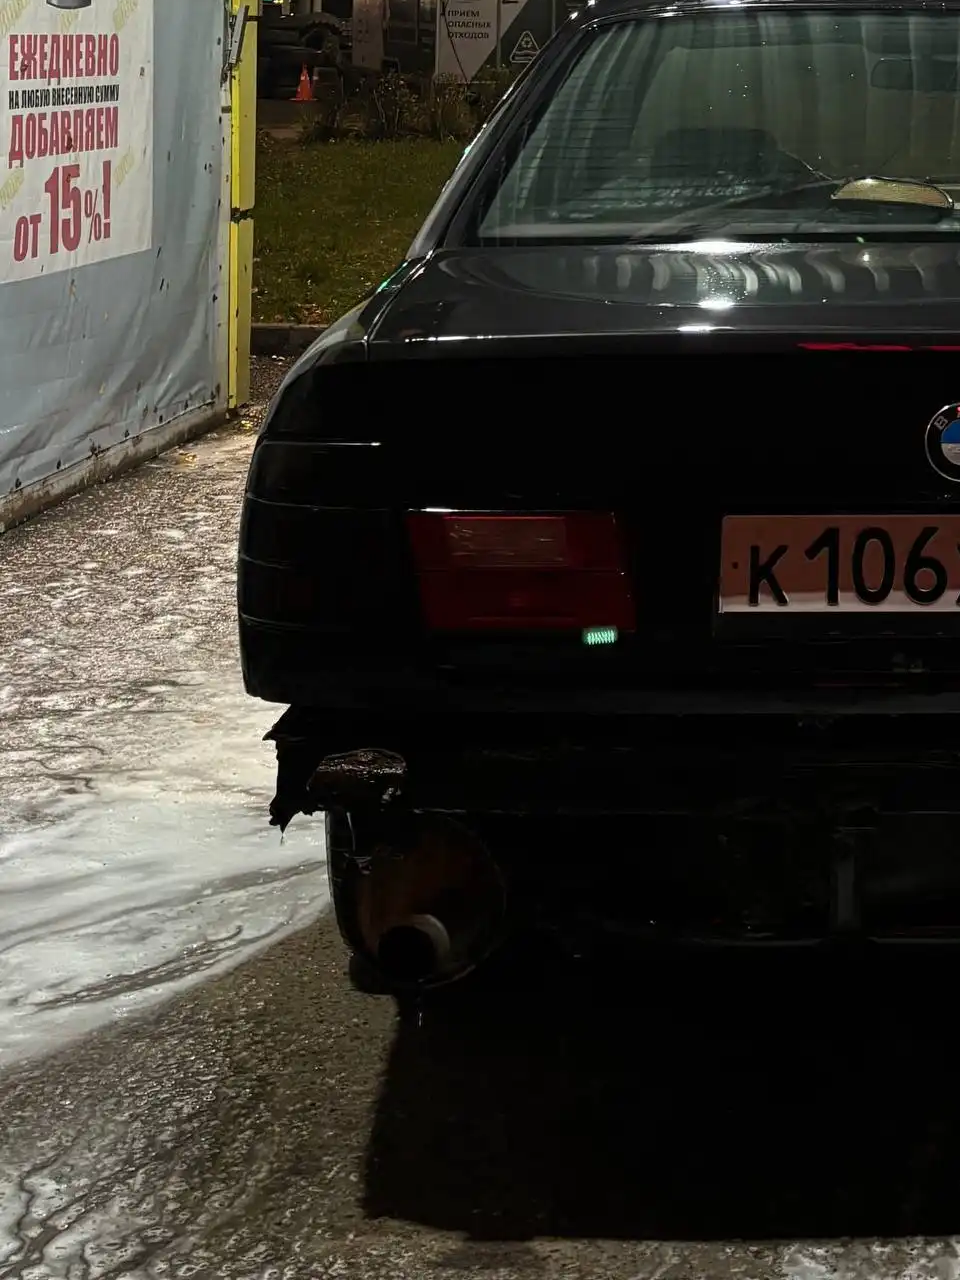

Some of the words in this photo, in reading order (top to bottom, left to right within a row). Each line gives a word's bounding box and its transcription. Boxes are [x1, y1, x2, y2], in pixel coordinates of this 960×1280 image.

[447, 20, 492, 29] ОПАСНЫХ
[447, 31, 490, 39] ОТХОДОВ
[9, 33, 120, 85] ЕЖЕДНЕВНО
[9, 90, 20, 110] НА
[21, 88, 50, 109] ЛЮБУЮ
[52, 86, 94, 107] ВНЕСЕННУЮ
[95, 84, 120, 103] СУММУ
[9, 106, 119, 169] ДОБАВЛЯЕМ
[44, 160, 112, 255] 15%!
